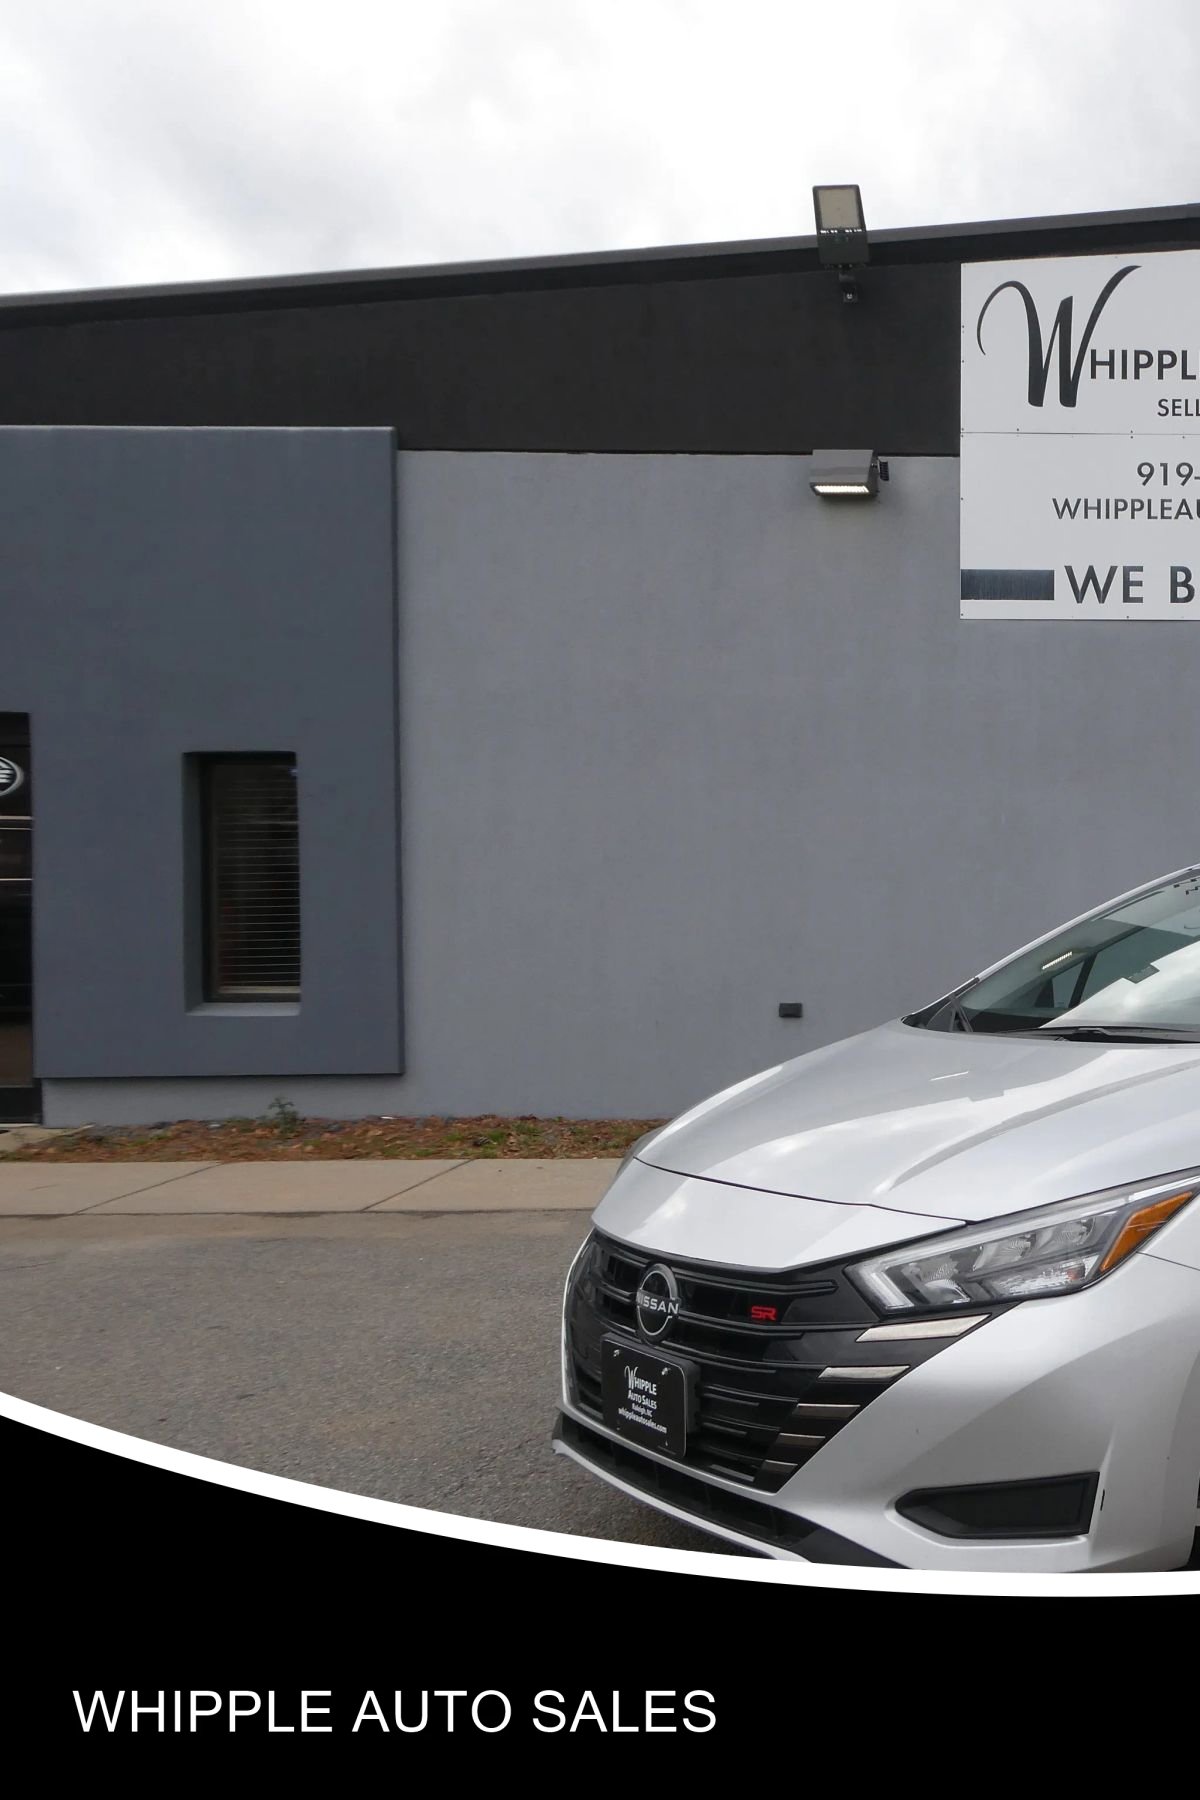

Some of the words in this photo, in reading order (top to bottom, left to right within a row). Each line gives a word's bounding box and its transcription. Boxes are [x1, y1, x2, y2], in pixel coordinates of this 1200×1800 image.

[1063, 564, 1144, 604] WE
[637, 1290, 679, 1314] NISSAN
[751, 1305, 777, 1321] SR
